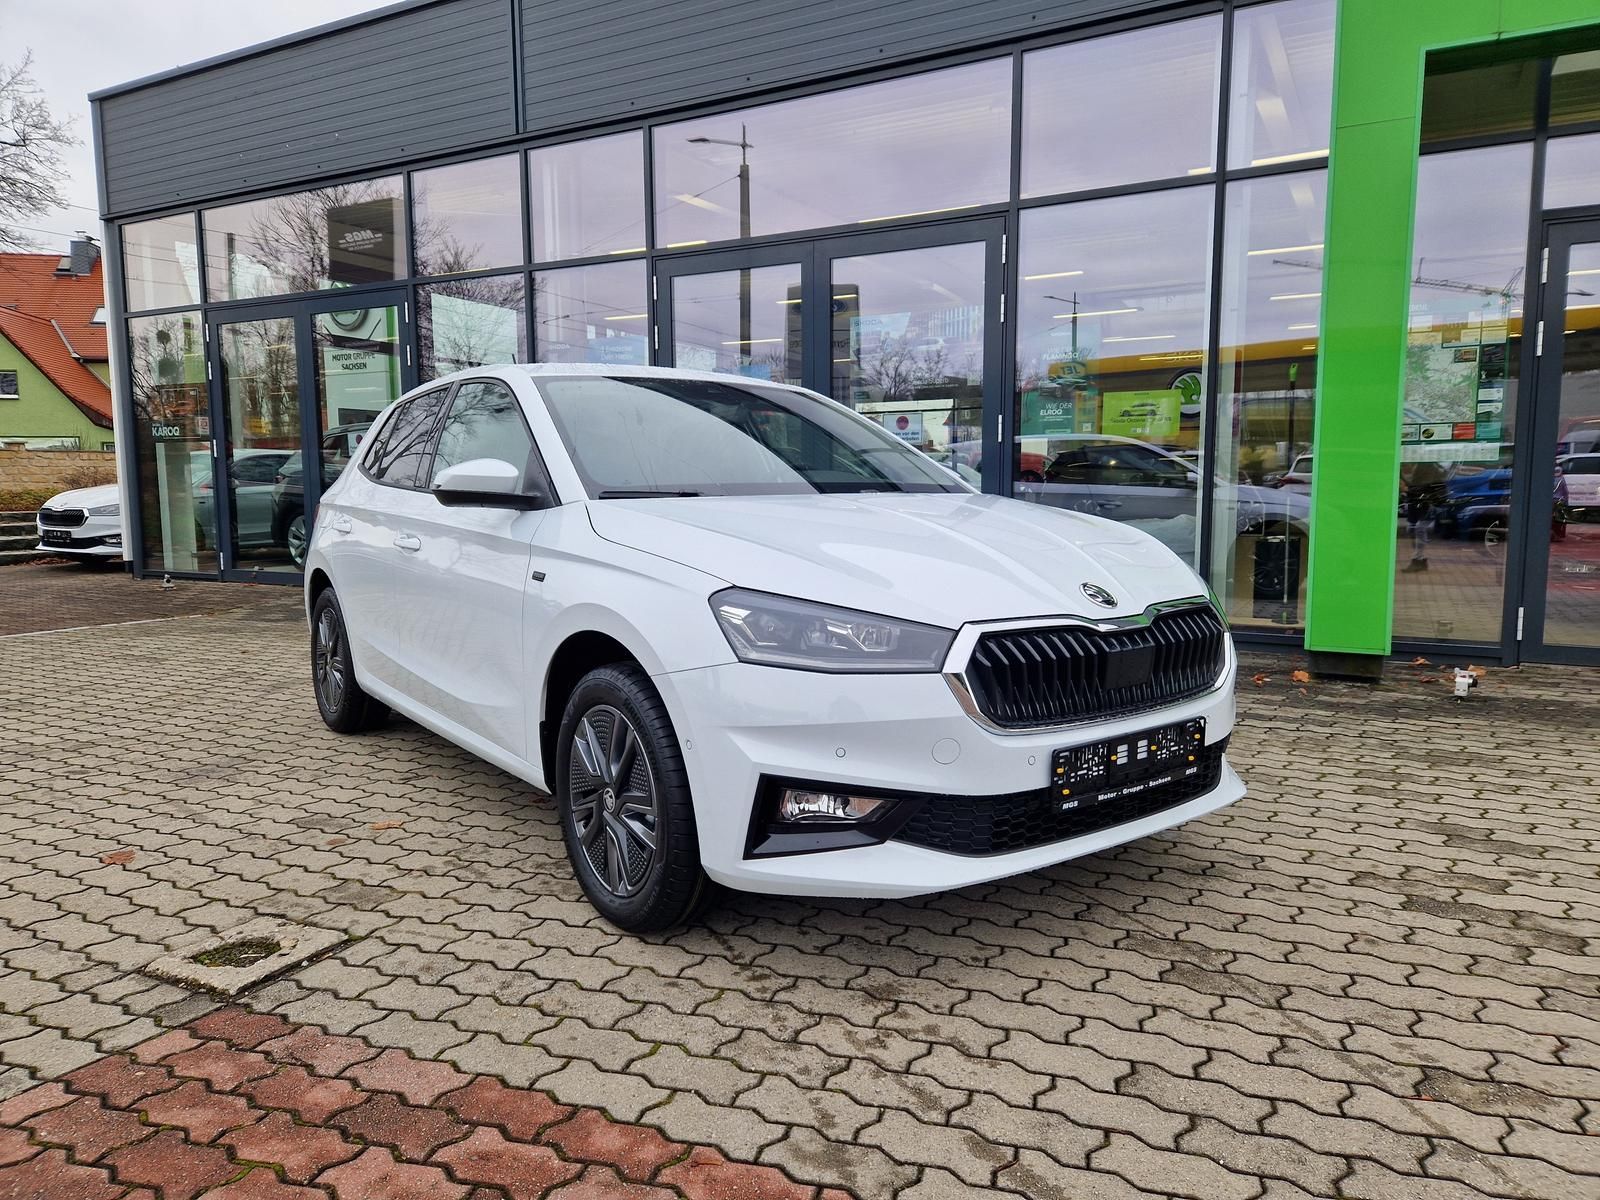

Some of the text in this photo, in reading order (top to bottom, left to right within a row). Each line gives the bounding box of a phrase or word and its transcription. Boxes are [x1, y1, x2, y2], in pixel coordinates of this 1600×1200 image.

[332, 352, 376, 362] MOTOR GRUPPE
[341, 362, 367, 370] SACHSEN
[151, 426, 180, 437] KAROQ
[1185, 766, 1198, 775] MGS
[1097, 791, 1117, 801] Motor
[1122, 784, 1144, 795] Gruppe
[1149, 776, 1172, 787] Sachsen
[1062, 800, 1079, 810] MGS
